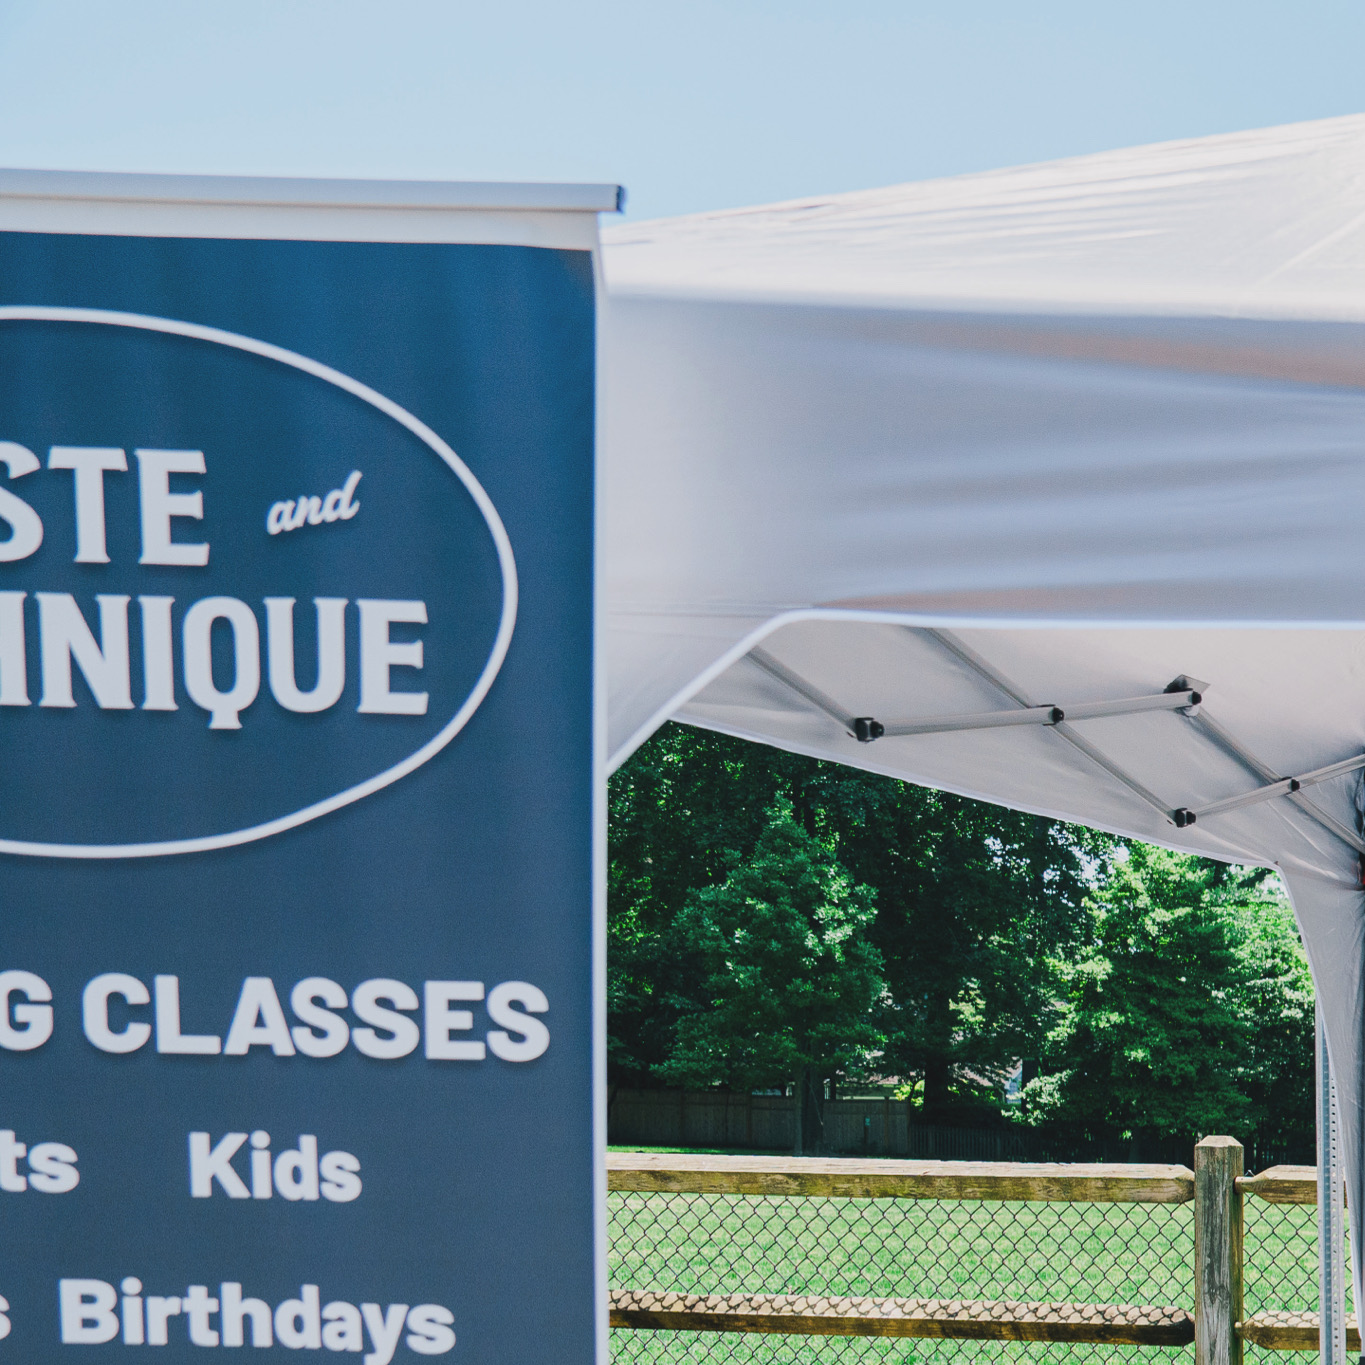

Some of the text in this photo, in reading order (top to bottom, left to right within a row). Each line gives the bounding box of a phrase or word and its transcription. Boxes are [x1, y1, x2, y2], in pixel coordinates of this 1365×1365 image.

[266, 471, 363, 534] and
[82, 972, 550, 1062] CLASSES
[188, 1131, 362, 1201] Kids
